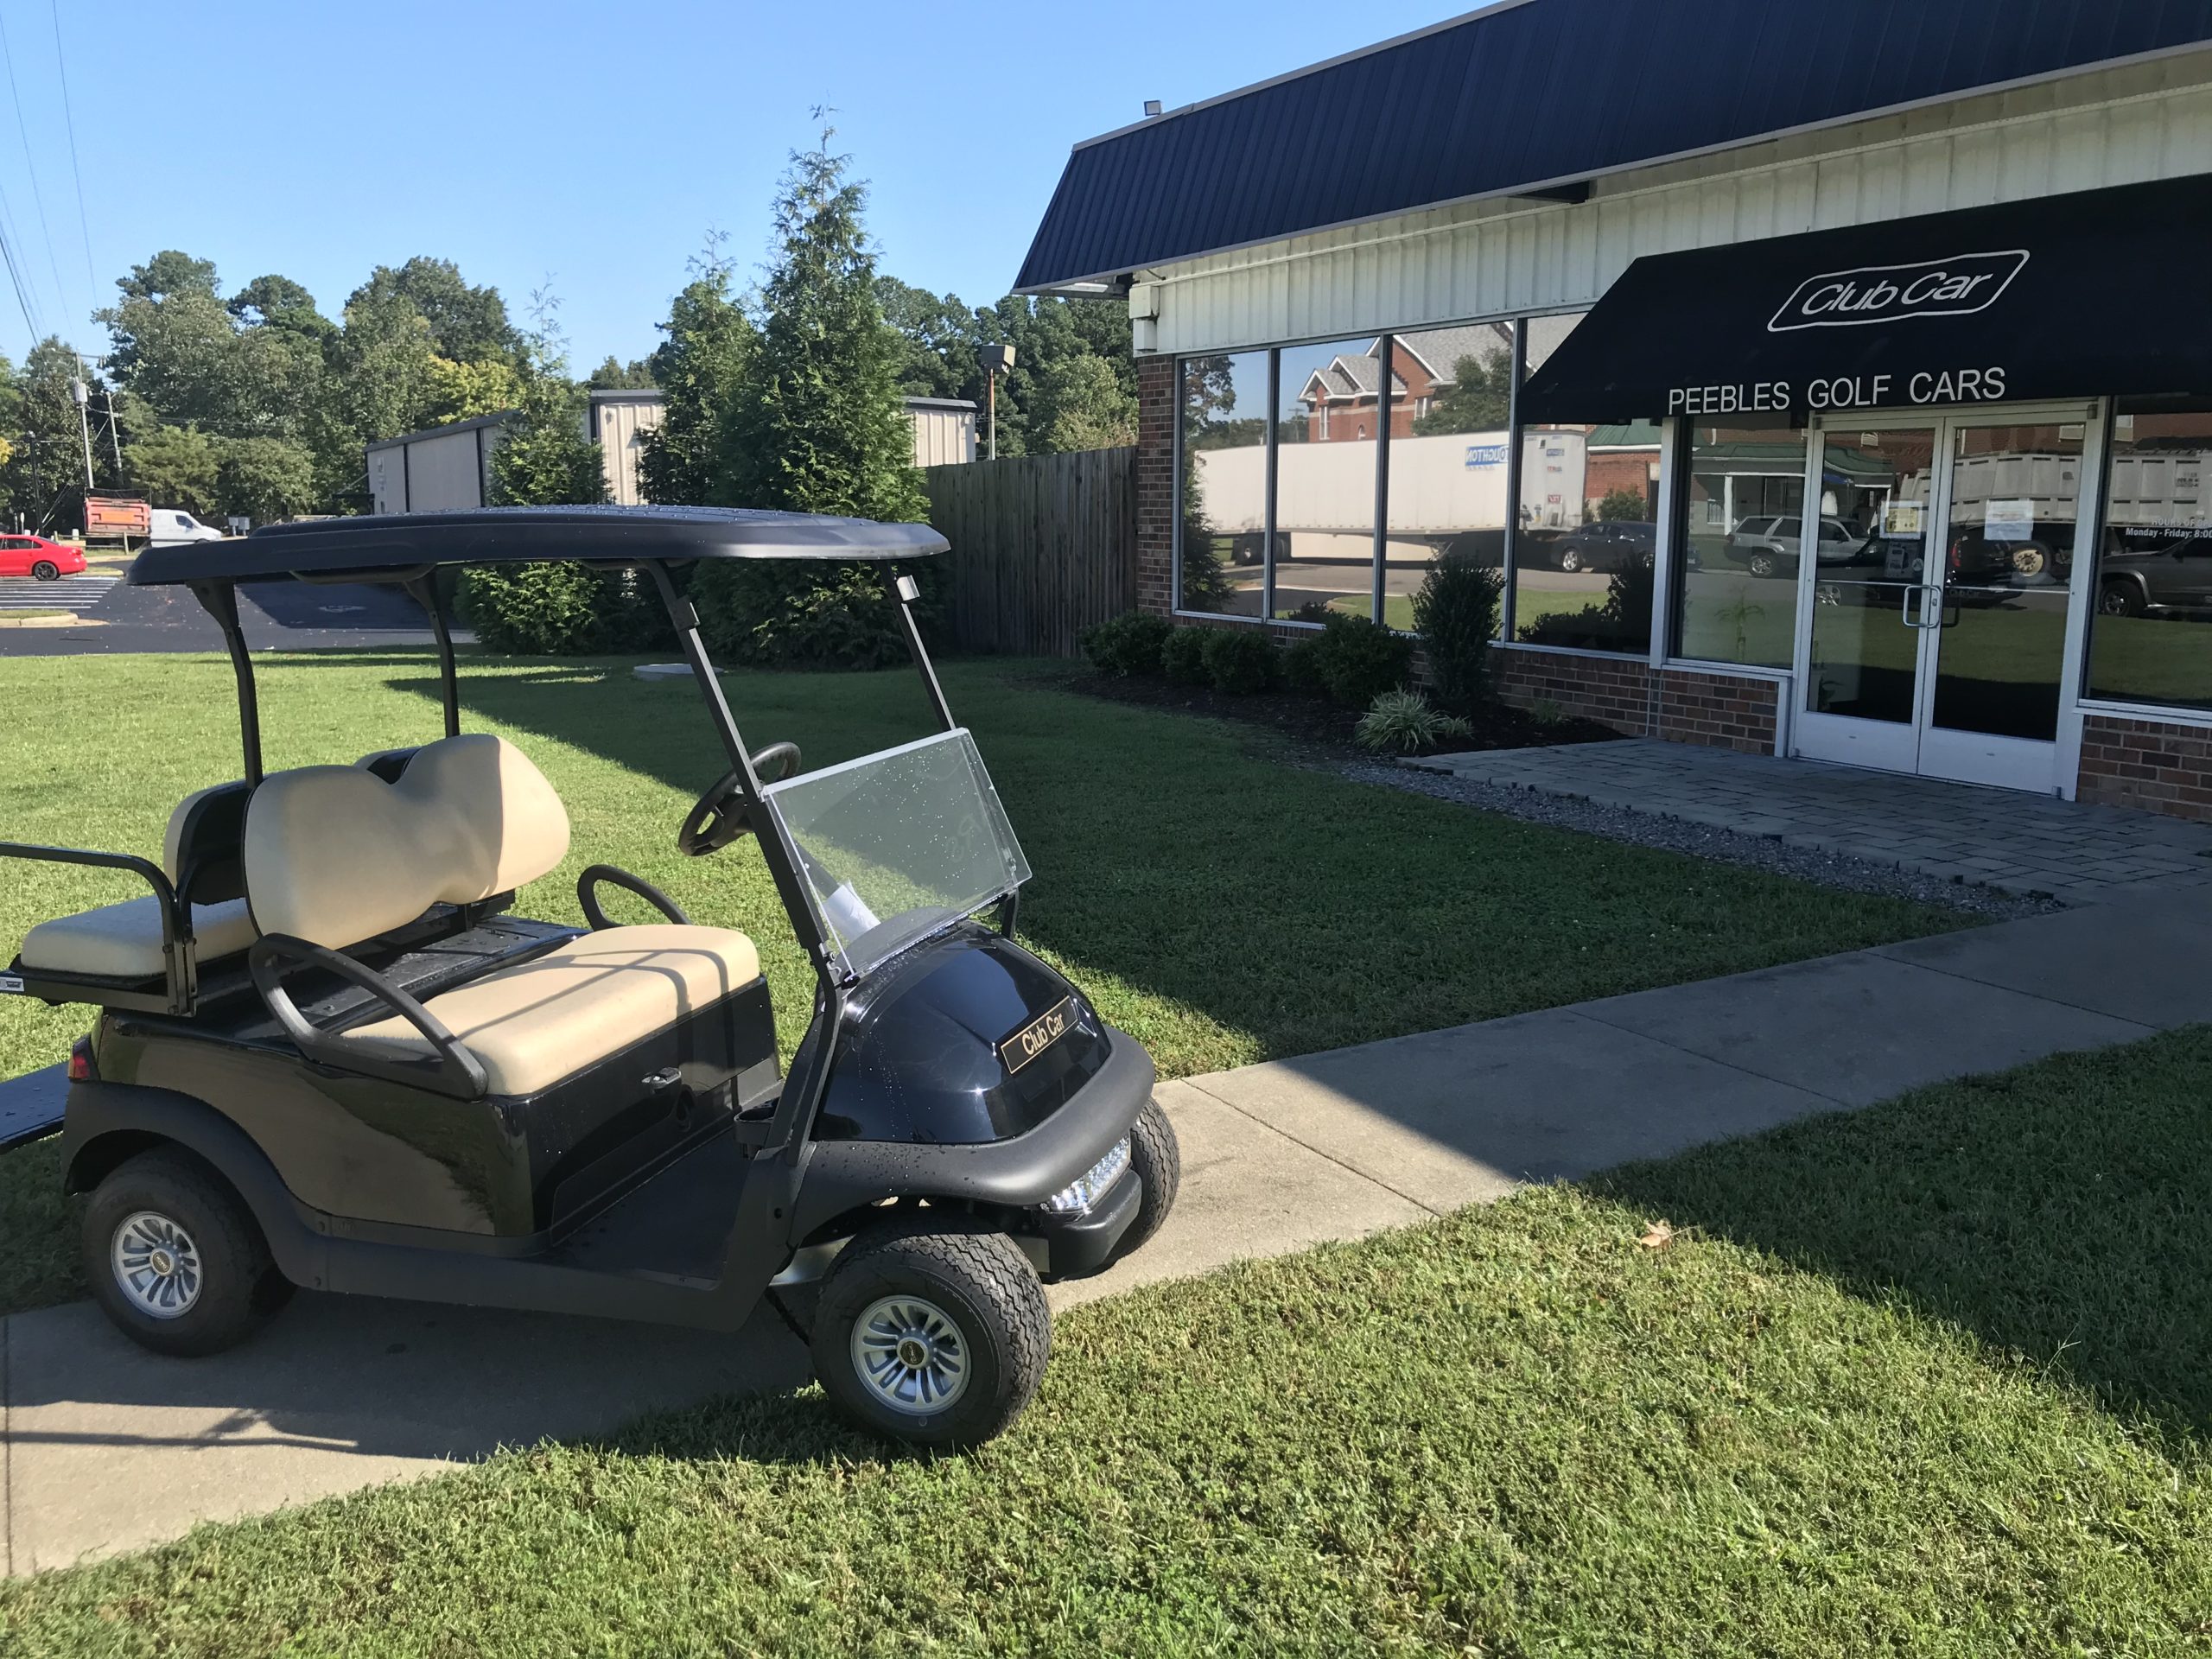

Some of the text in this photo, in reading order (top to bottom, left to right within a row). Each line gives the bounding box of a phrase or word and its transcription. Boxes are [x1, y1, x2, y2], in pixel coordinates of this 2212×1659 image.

[1802, 272, 1993, 315] Club Car
[1669, 366, 2005, 416] PEEBLES GOLF CARS
[2126, 527, 2158, 537] Monday
[1022, 1013, 1065, 1055] Club Car
